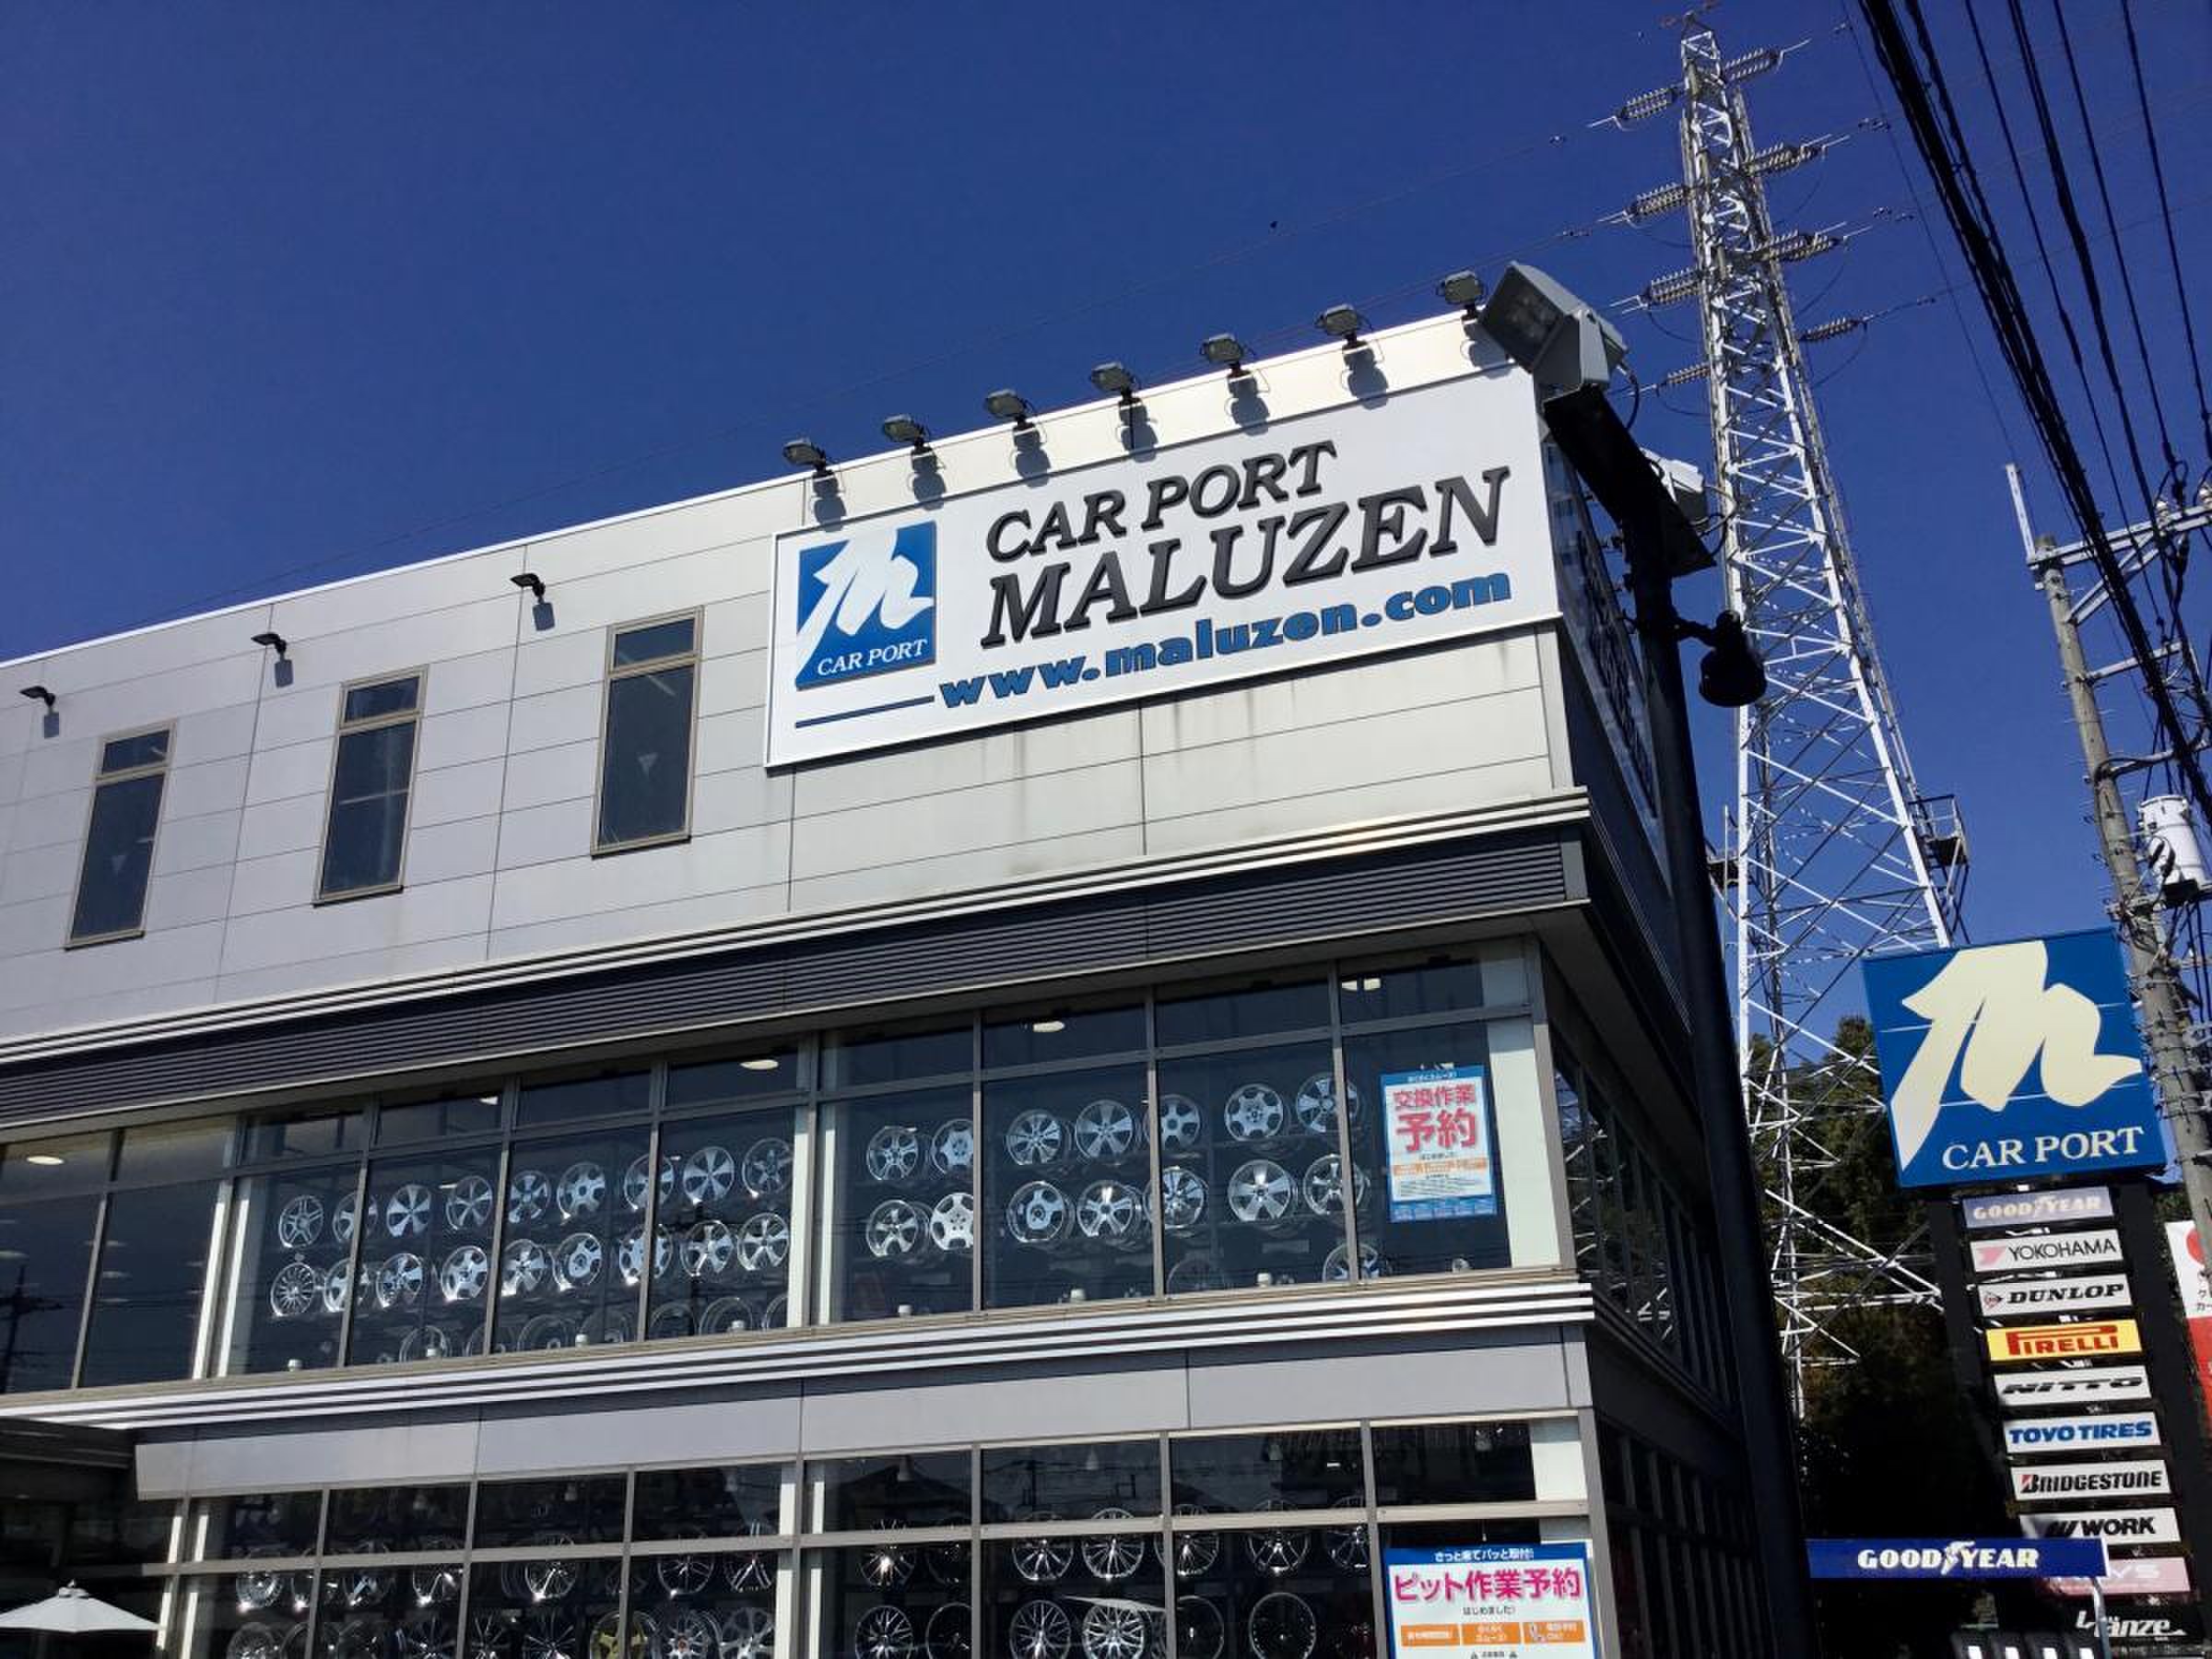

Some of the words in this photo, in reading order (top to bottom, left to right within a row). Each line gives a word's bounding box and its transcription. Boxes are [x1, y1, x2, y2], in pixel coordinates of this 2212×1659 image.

[986, 489, 1127, 563] CAR
[1141, 440, 1337, 532] PORT
[981, 465, 1511, 650] MALUZEN
[818, 653, 864, 676] CAR
[866, 639, 928, 665] PORT
[1395, 1108, 1477, 1152] 予約
[1942, 1139, 2027, 1171] CAR
[2035, 1126, 2145, 1162] PORT
[2008, 1239, 2117, 1262] YOKOHAMA
[2006, 1284, 2124, 1304] DUNLOP
[2006, 1324, 2119, 1356] PIRELLI
[2002, 1377, 2144, 1394] NITTO
[2008, 1426, 2074, 1444] TOYO
[2077, 1420, 2152, 1441] TIRES
[2020, 1471, 2163, 1494] BRIDGESTONE
[2081, 1516, 2157, 1536] WORK
[1394, 1566, 1582, 1602] ピット作業予約
